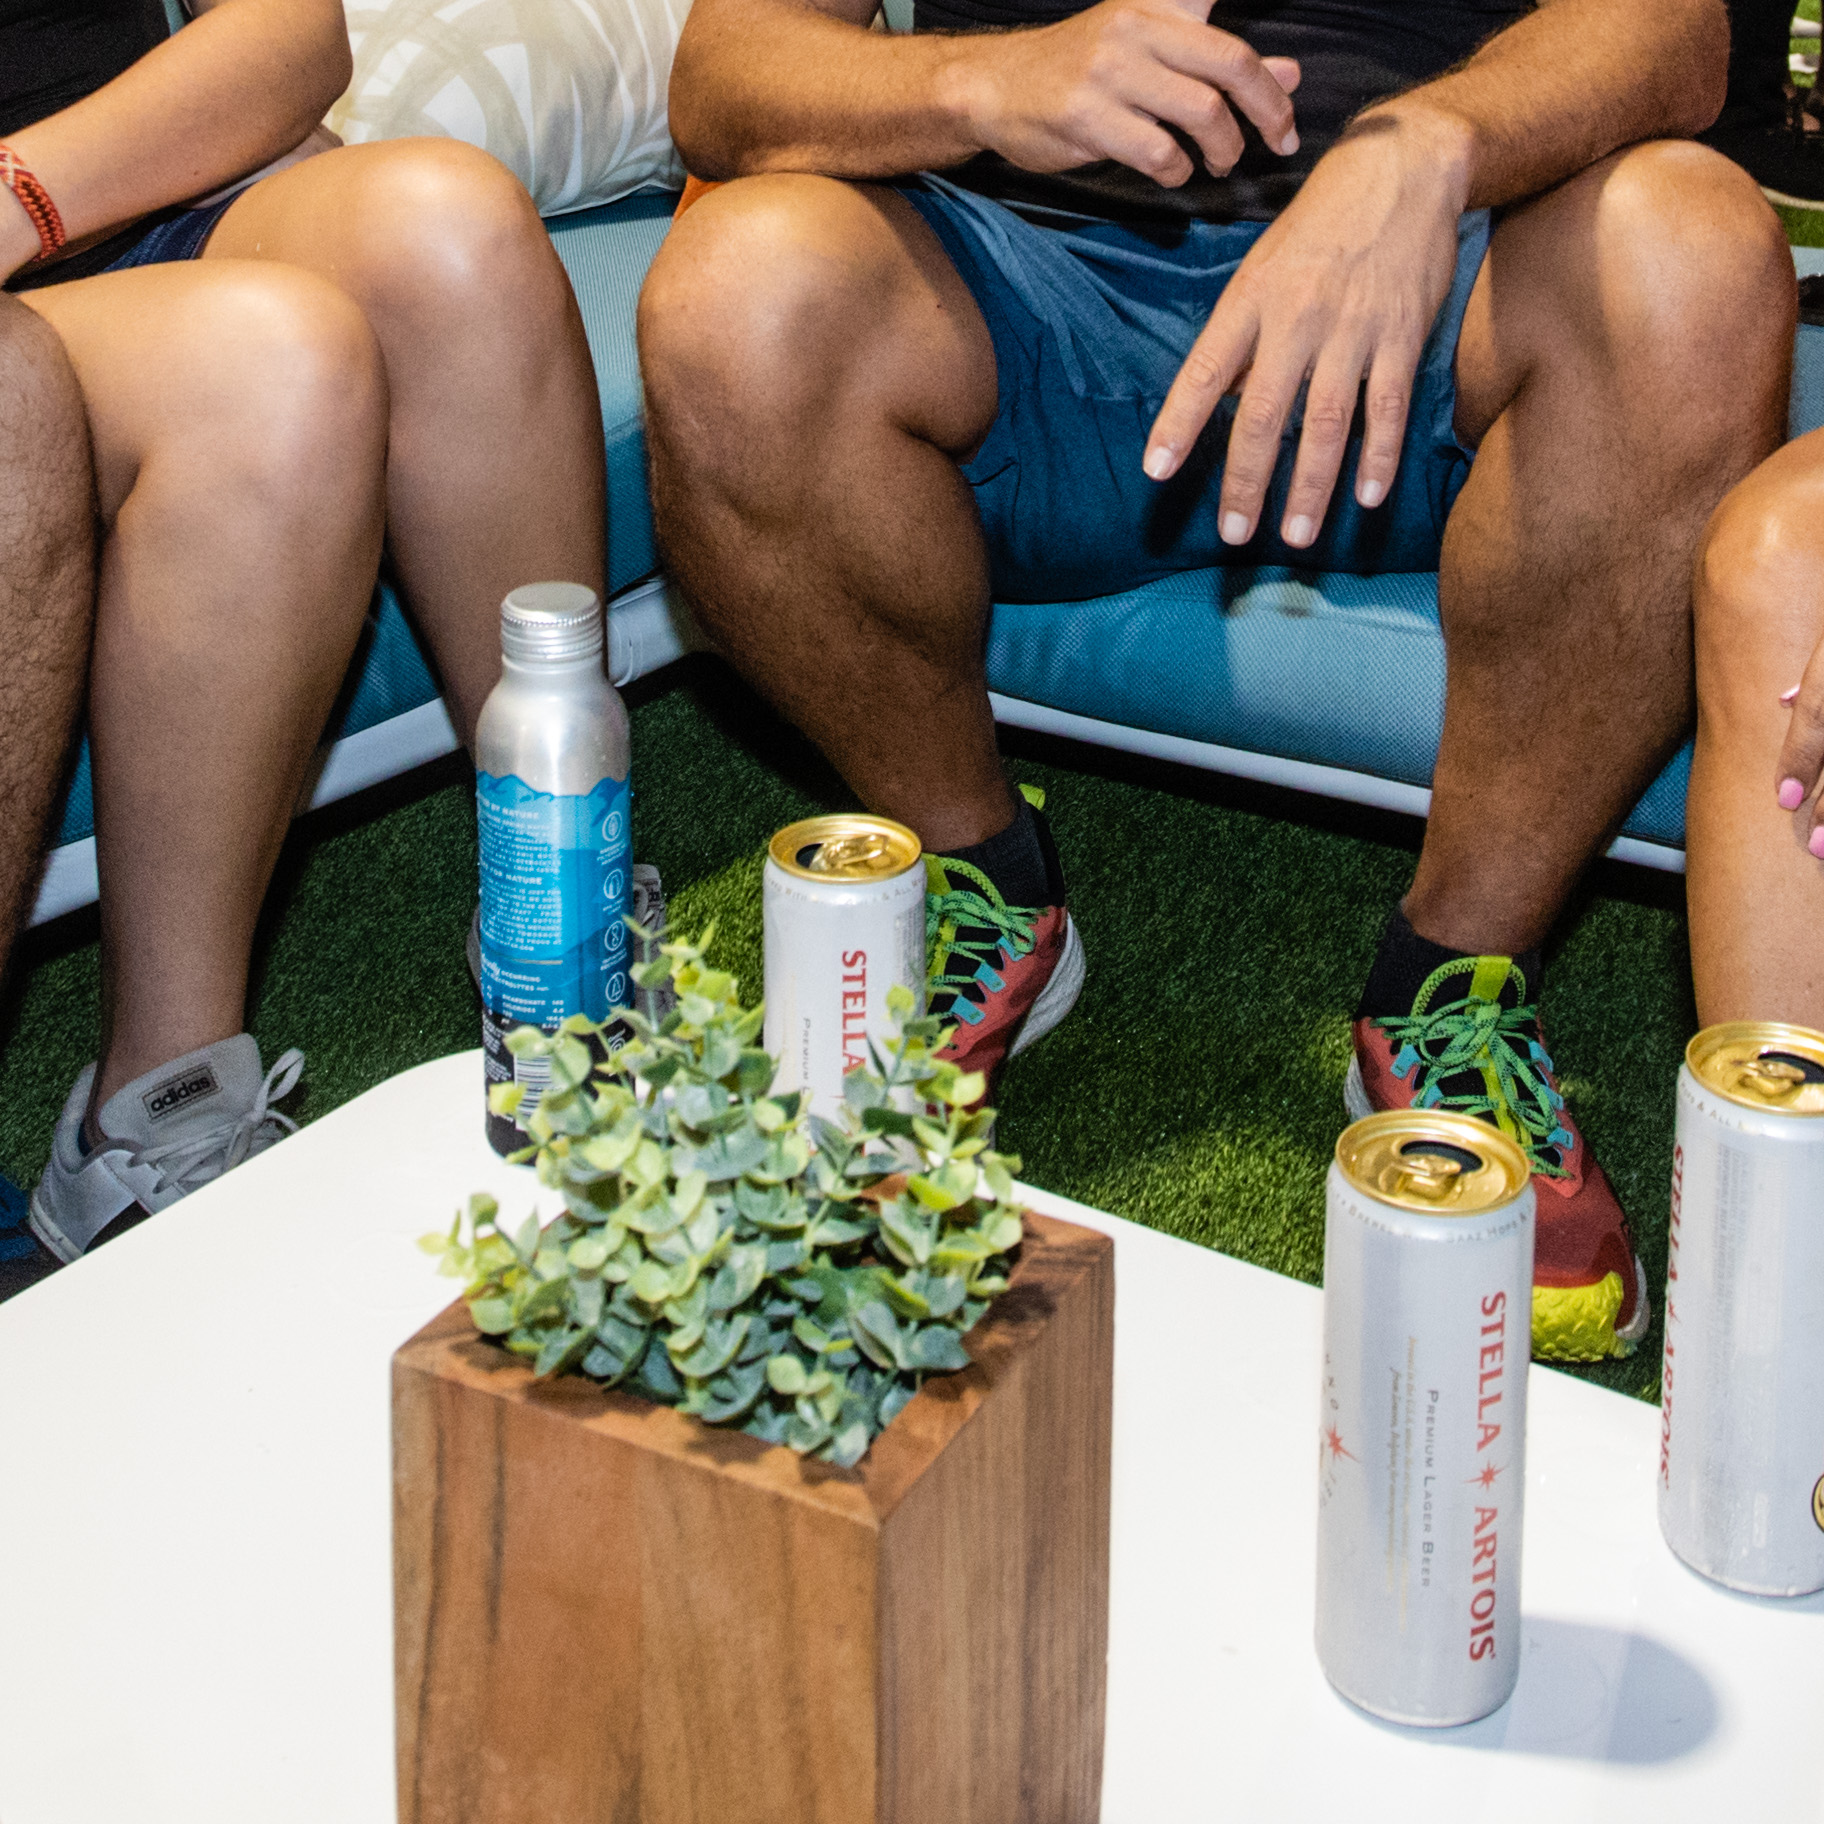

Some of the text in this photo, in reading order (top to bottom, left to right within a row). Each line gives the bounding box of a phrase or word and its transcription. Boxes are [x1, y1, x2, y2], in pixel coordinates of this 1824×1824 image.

[506, 874, 543, 886] NATURE
[802, 1017, 811, 1080] PREMIUM
[842, 950, 867, 1076] STELLA
[151, 1077, 211, 1112] adidas
[1421, 1389, 1440, 1587] PREMIUM LAGER BEER
[1469, 1290, 1507, 1662] STELLA ARTOIS
